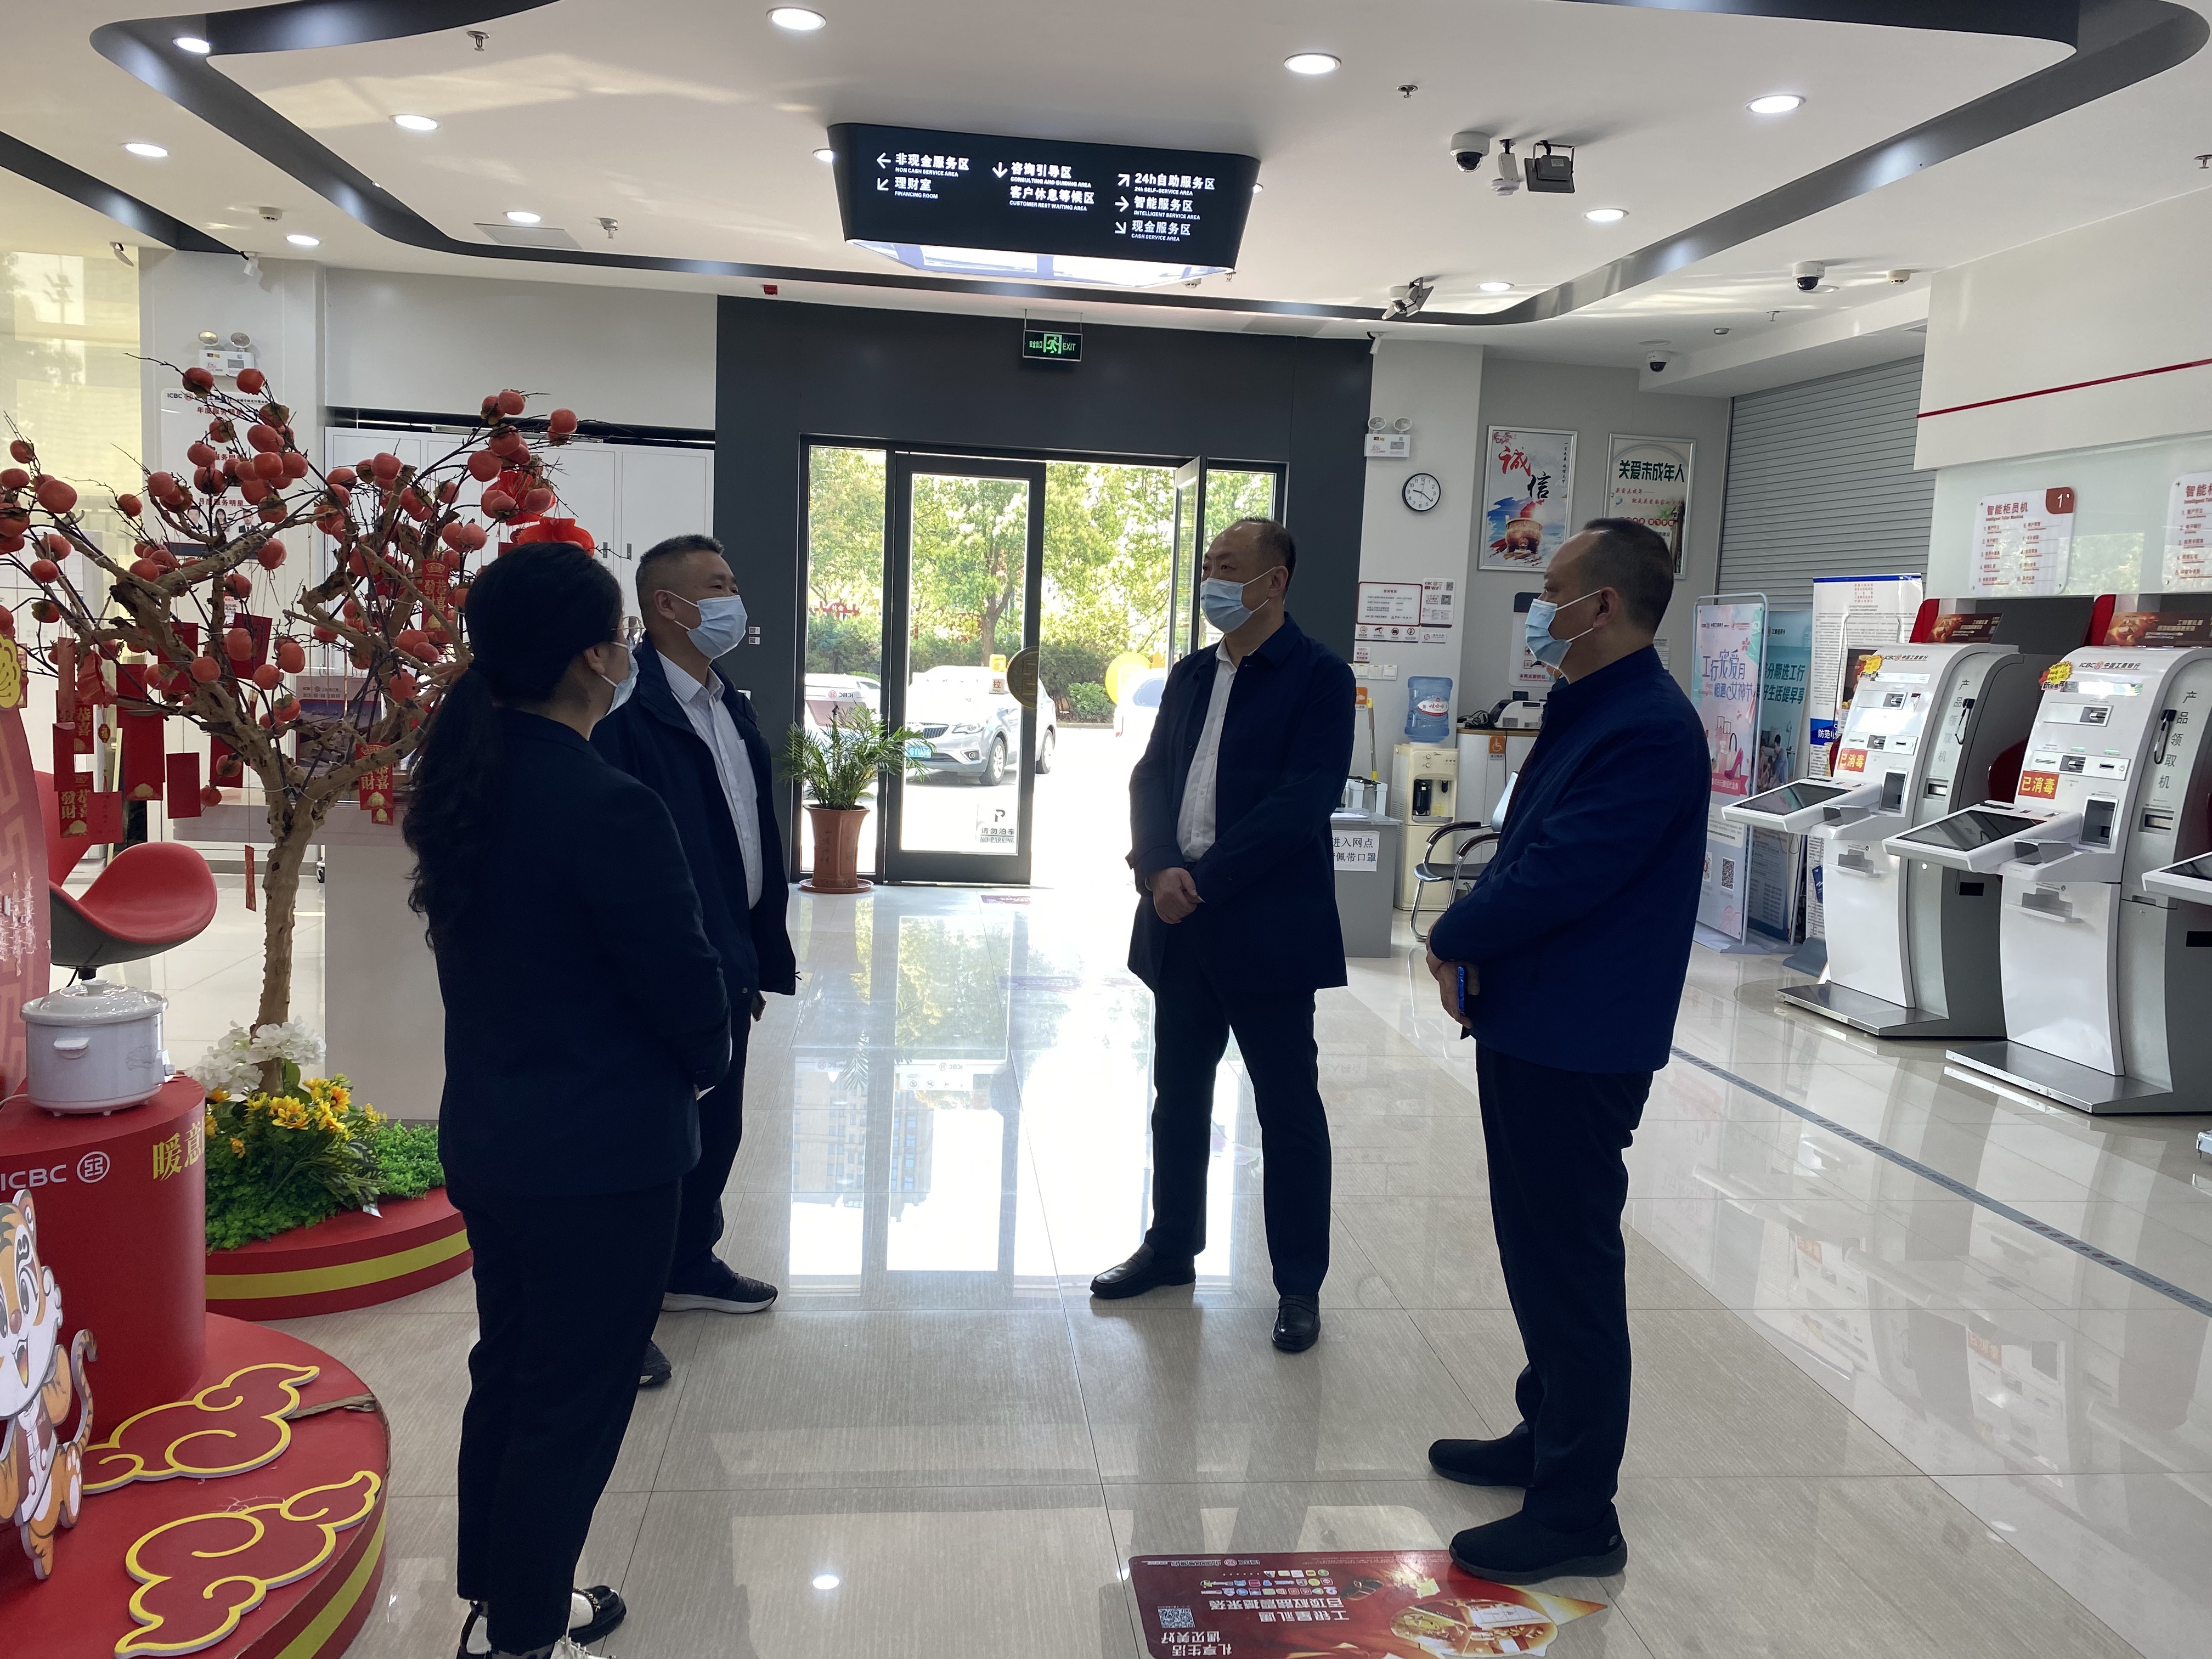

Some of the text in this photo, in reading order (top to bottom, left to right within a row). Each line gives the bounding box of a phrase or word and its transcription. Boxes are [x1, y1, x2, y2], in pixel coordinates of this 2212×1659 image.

[895, 153, 969, 170] 非现金服务区
[1011, 161, 1071, 178] 咨询引导区
[894, 176, 932, 191] 理财室
[1135, 172, 1215, 190] 24h自助服务区
[1010, 185, 1094, 204] 客户休息等候区
[1134, 195, 1193, 212] 智能服务区
[1131, 219, 1191, 235] 现金服务区
[1062, 342, 1076, 351] EXIT
[1619, 460, 1685, 483] 关爱未成年人
[1987, 493, 2063, 516] 智能柜员机 1
[1702, 648, 1745, 681] 工行宠爱月
[992, 680, 1001, 689] 拉
[2158, 690, 2198, 789] 产品领取机
[1839, 753, 1865, 769] 已消毒
[2021, 776, 2055, 794] 已消毒
[1333, 837, 1373, 848] 进入网点
[1333, 851, 1376, 863] 佩带口罩
[1, 1164, 67, 1192] ICBC
[1171, 1643, 1232, 1657] 礼享生活
